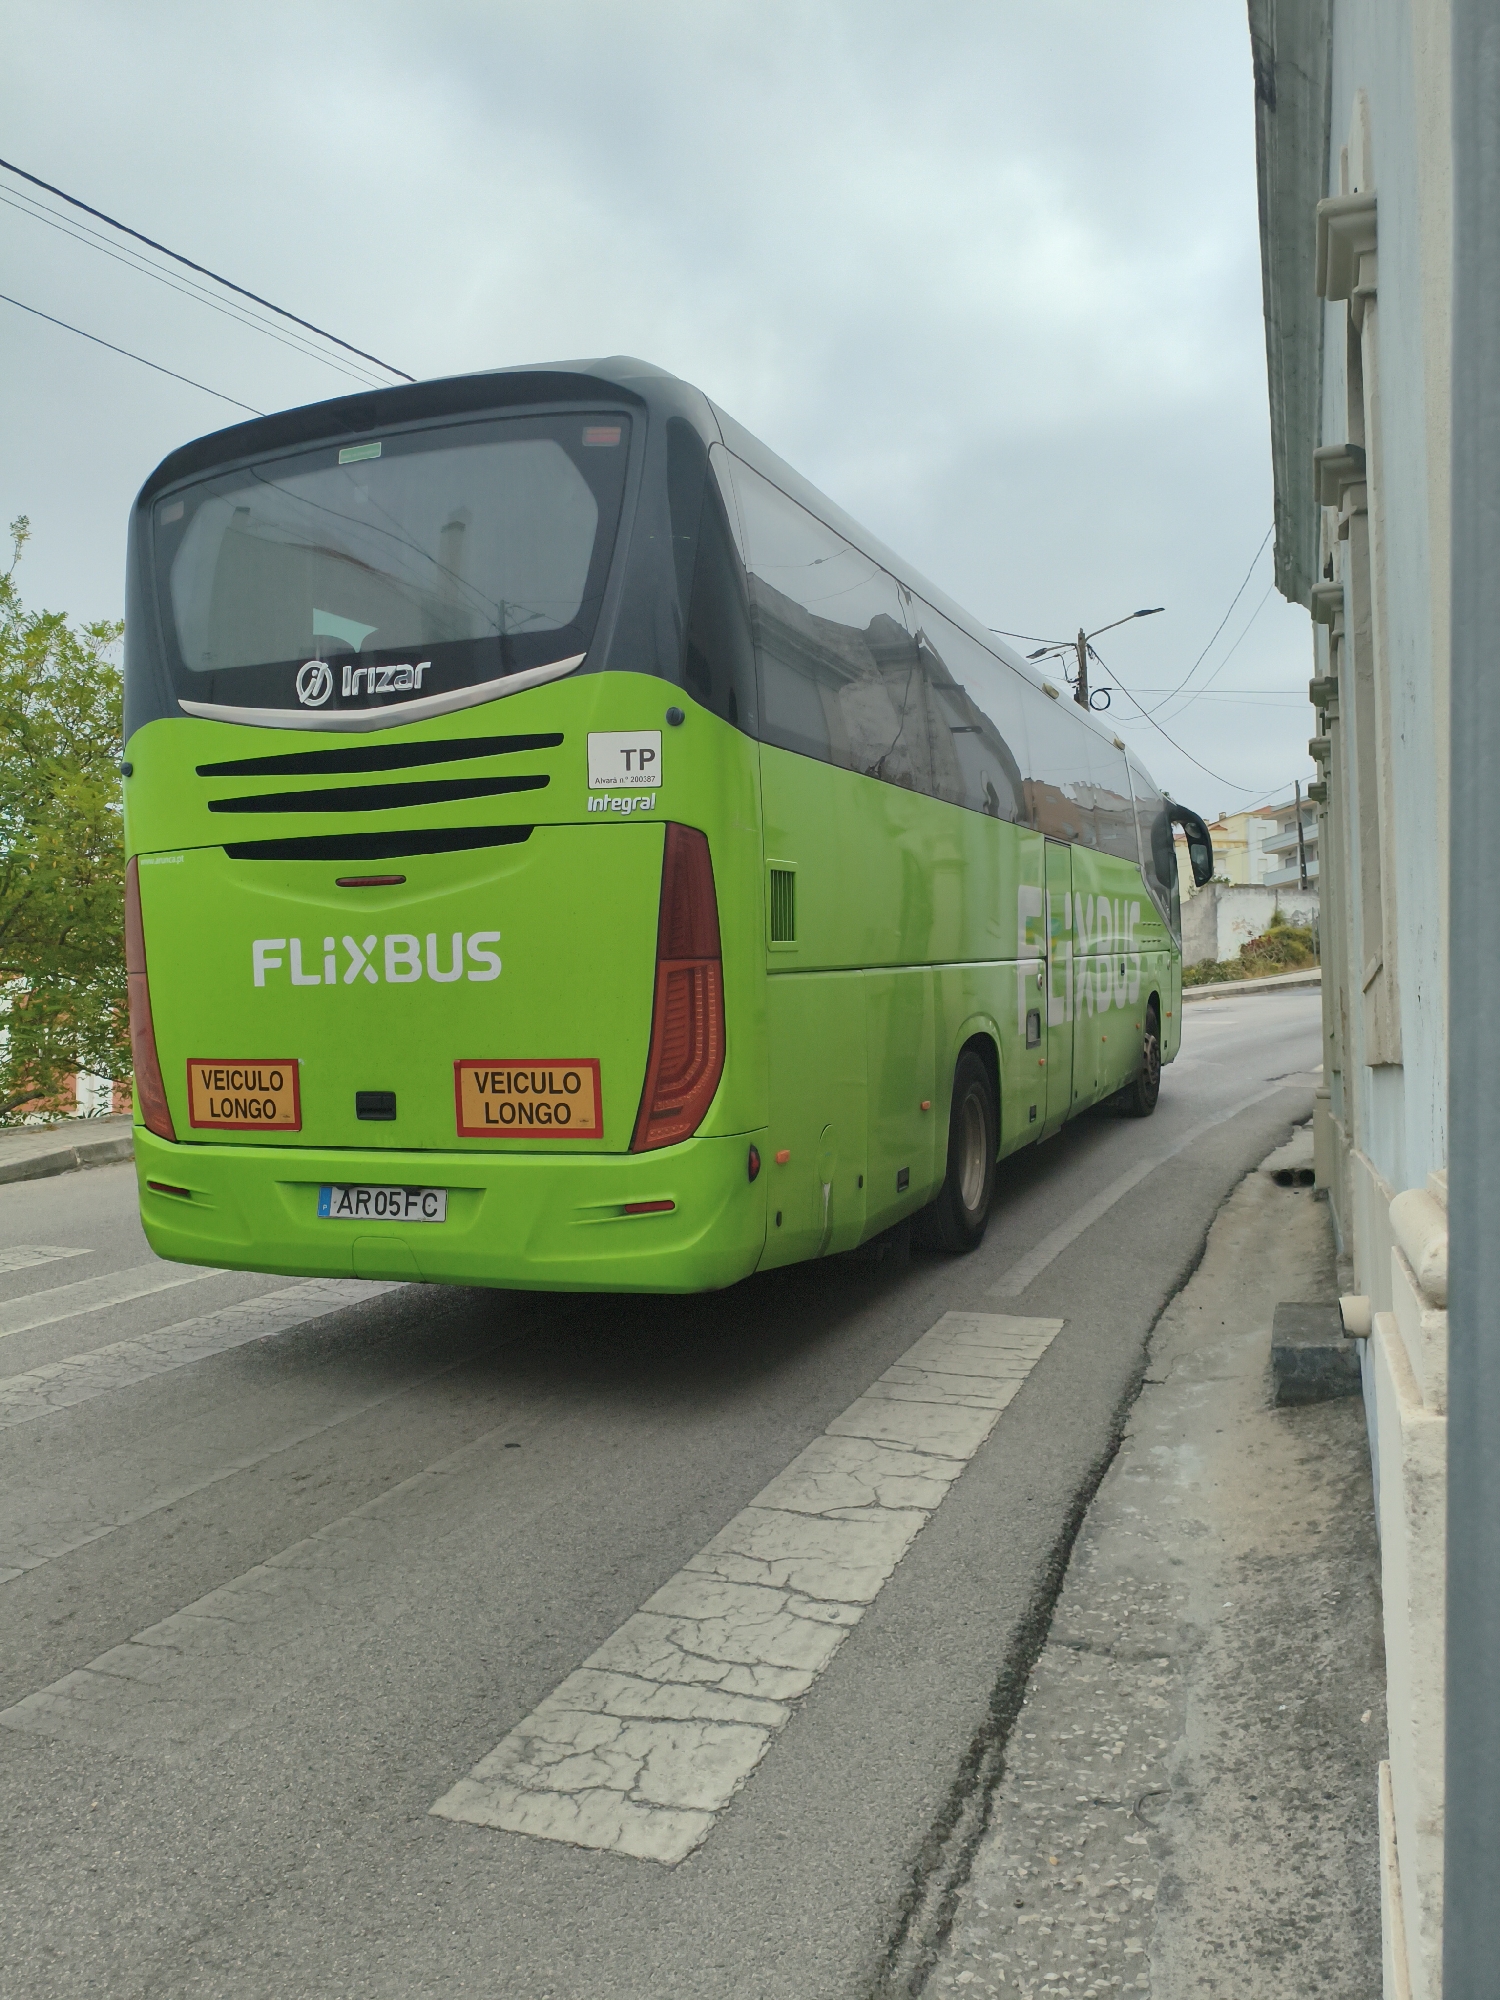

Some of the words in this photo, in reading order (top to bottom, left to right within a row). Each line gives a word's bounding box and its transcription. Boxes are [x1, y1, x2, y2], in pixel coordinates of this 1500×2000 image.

[341, 661, 432, 697] Irizar
[620, 748, 656, 771] TP
[594, 776, 618, 785] Alvará
[630, 775, 656, 783] 200387
[587, 792, 656, 815] Integral
[201, 1069, 284, 1092] VEICULO
[474, 1071, 582, 1095] VEICULO
[209, 1097, 277, 1120] LONGO
[485, 1102, 572, 1125] LONGO
[336, 1188, 438, 1218] AR05FC
